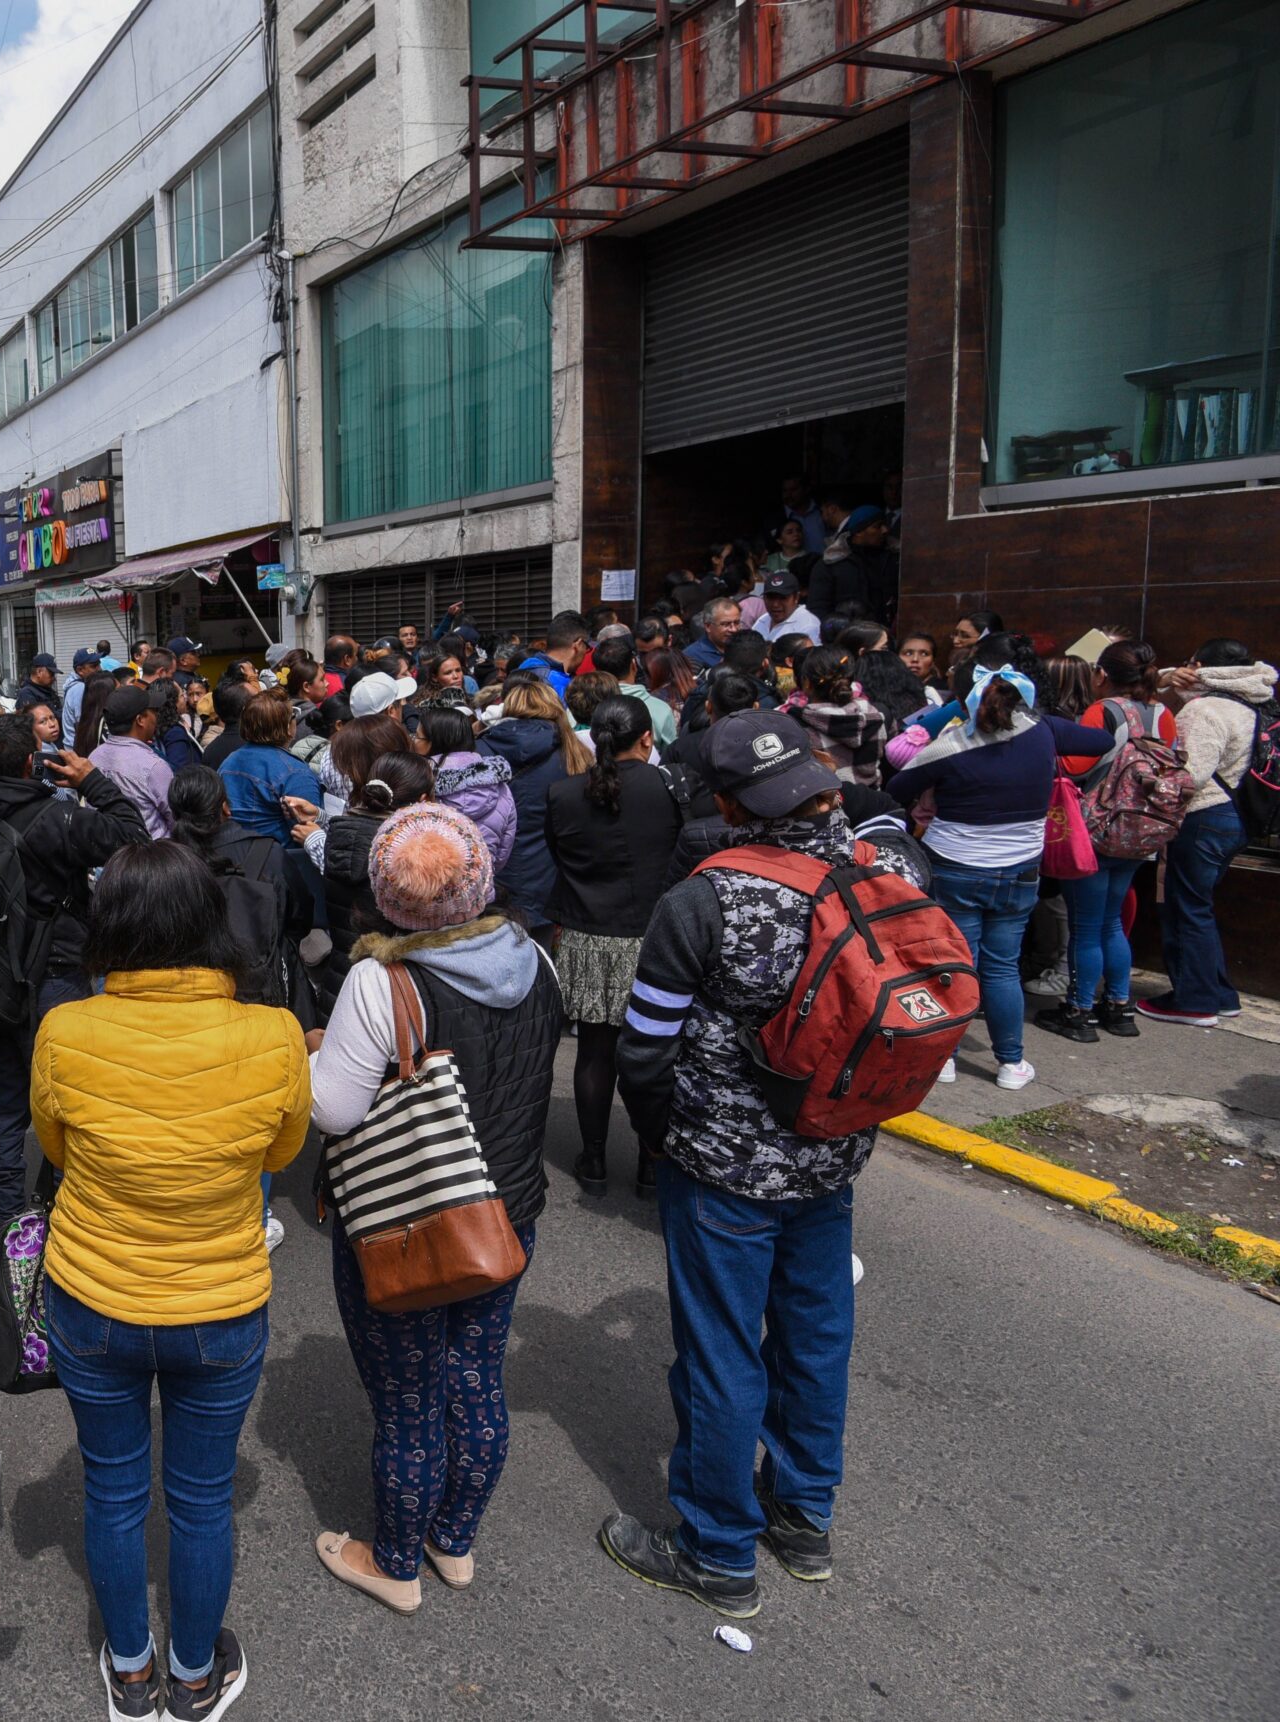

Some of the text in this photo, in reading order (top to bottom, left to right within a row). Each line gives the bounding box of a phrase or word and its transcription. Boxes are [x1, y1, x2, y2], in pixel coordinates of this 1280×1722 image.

[61, 480, 107, 513] TODO PARA
[18, 520, 69, 573] GLOBO
[74, 516, 109, 548] FIESTA
[751, 747, 801, 774] JOHN DEERE
[900, 992, 942, 1020] 23
